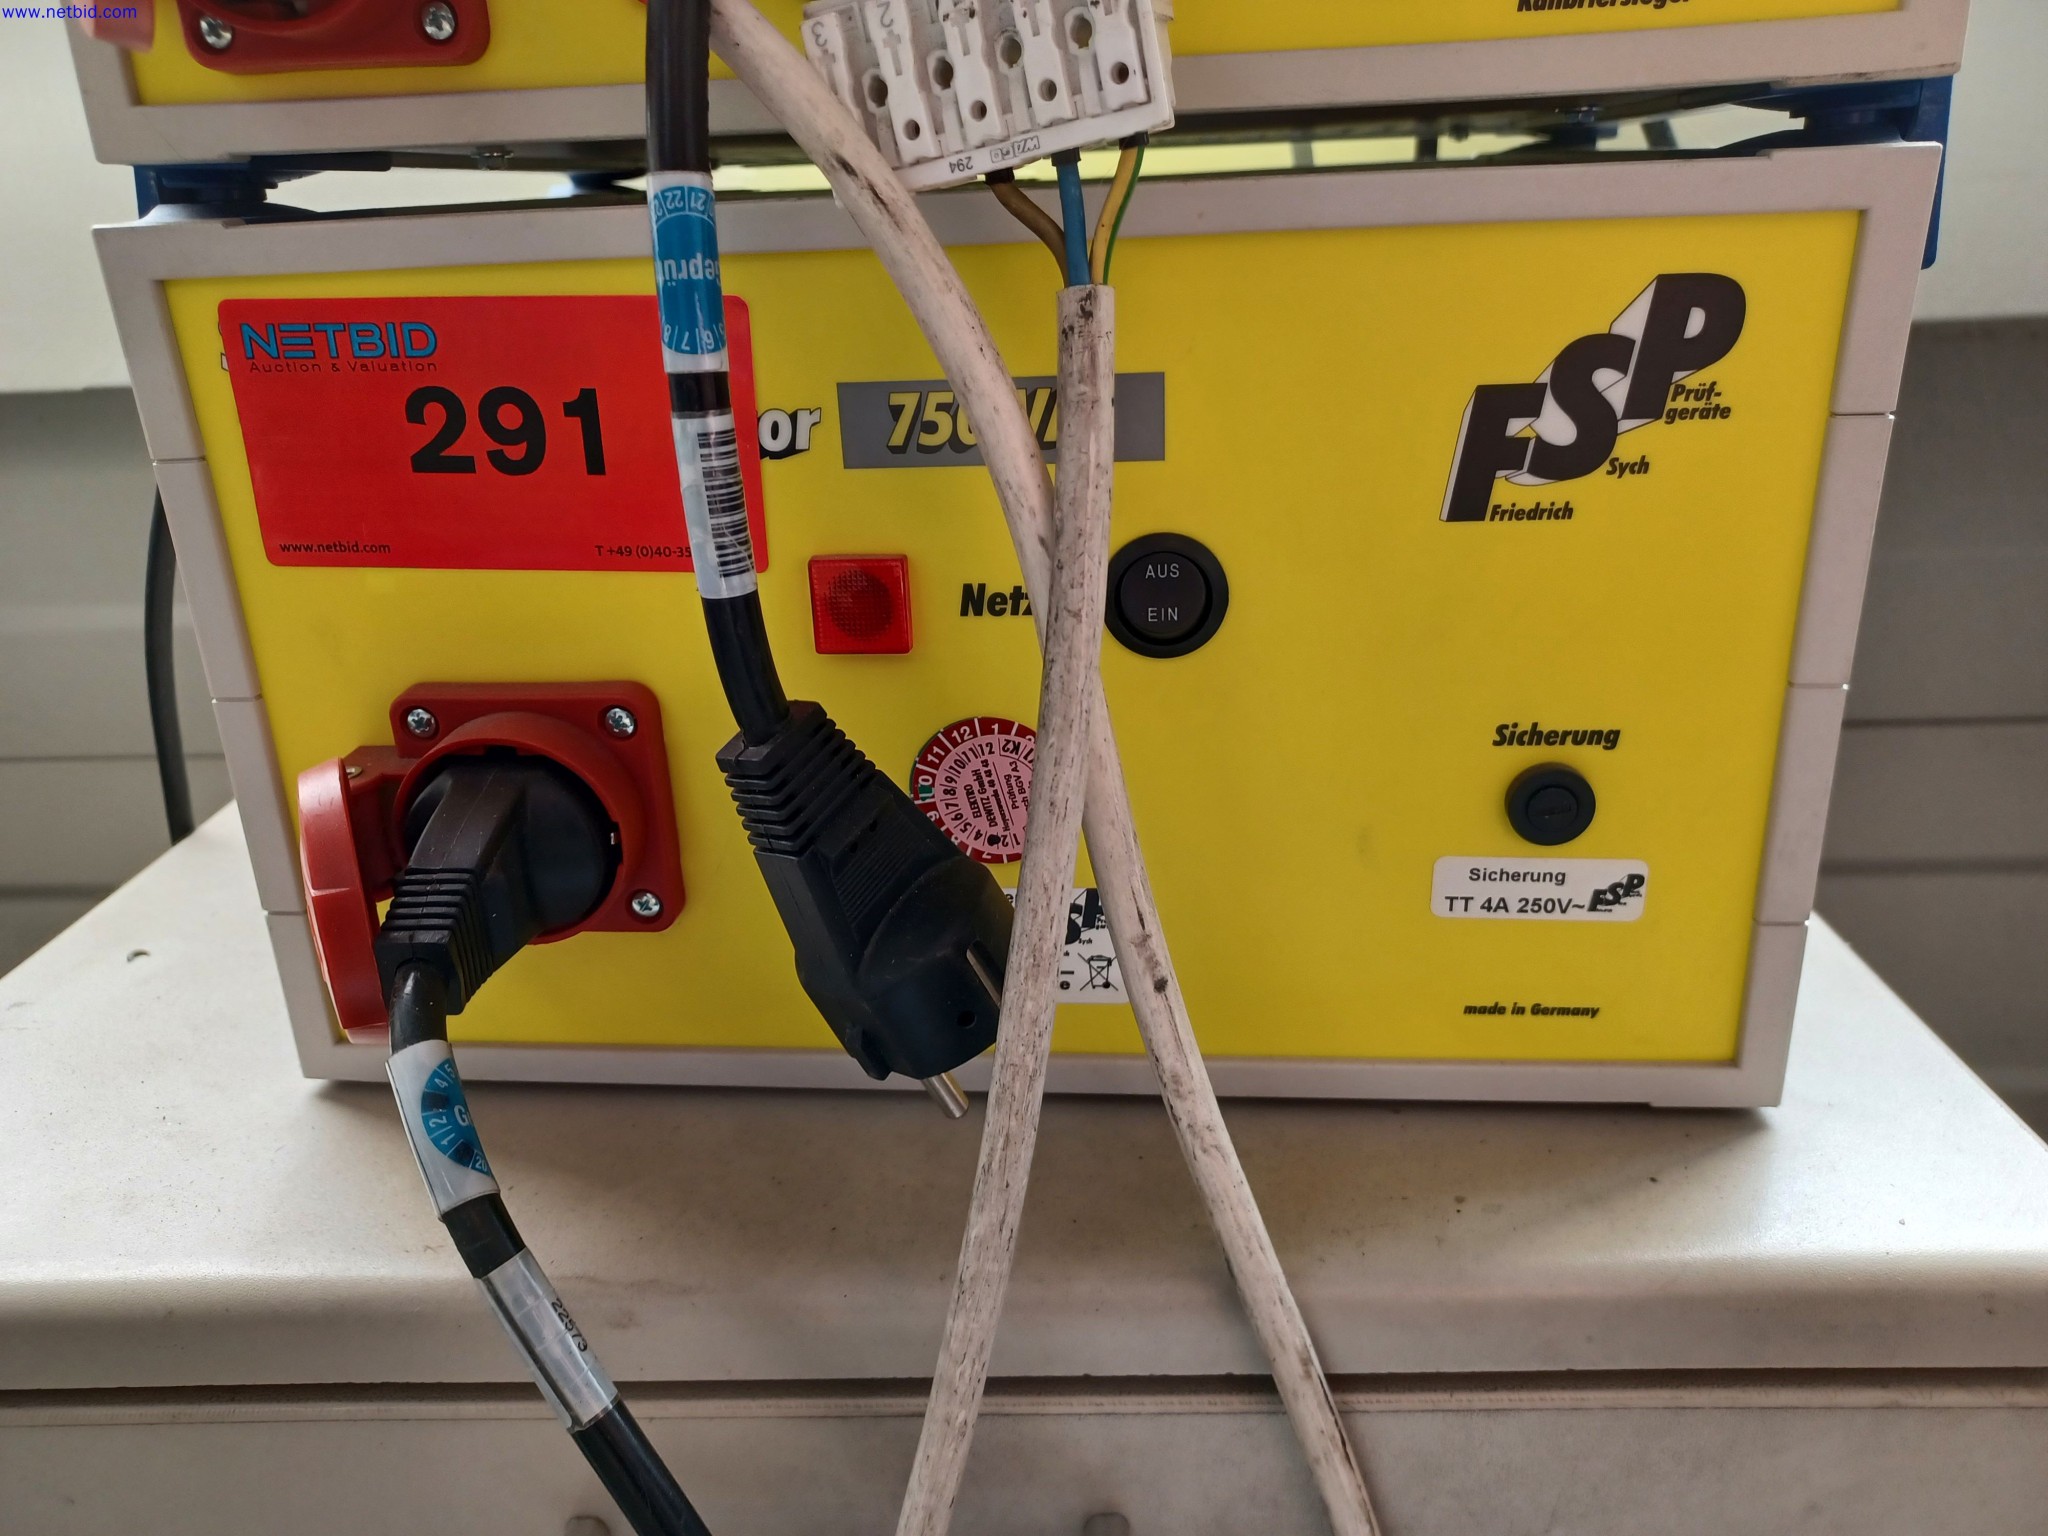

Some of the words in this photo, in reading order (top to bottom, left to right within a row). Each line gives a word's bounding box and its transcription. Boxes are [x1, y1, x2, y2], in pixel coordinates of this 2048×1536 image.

[949, 156, 974, 174] 294
[665, 189, 684, 209] 22
[240, 322, 437, 360] NETBID
[250, 361, 322, 373] Auction
[331, 362, 341, 373] &
[347, 360, 437, 373] Valuation
[1439, 272, 1746, 522] FSP
[1670, 381, 1722, 402] Prüf-
[1664, 402, 1731, 425] geräte
[404, 385, 607, 476] 291
[1606, 455, 1650, 479] Sych
[1489, 501, 1574, 522] Friedrich
[279, 540, 391, 555] www.netbid.com
[595, 545, 604, 556] T
[607, 545, 632, 557] +49
[1145, 563, 1180, 579] AUS
[1147, 607, 1179, 622] EIN
[927, 745, 945, 764] 11
[951, 726, 974, 744] 12
[1492, 722, 1621, 750] Sicherung
[1001, 738, 1022, 756] K2
[948, 759, 967, 775] 10
[961, 747, 979, 763] 11
[977, 741, 996, 756] 12
[1008, 760, 1020, 773] A3
[1003, 773, 1020, 810] Prüfung
[1013, 774, 1027, 796] BGV
[963, 784, 983, 819] ELEKTRO
[1468, 867, 1567, 886] Sicherung
[1587, 873, 1645, 912] FSP
[1444, 896, 1474, 912] TT
[1480, 896, 1510, 913] 4A
[1463, 1002, 1507, 1016] made
[1511, 1003, 1526, 1016] in
[1530, 1003, 1600, 1019] Germany
